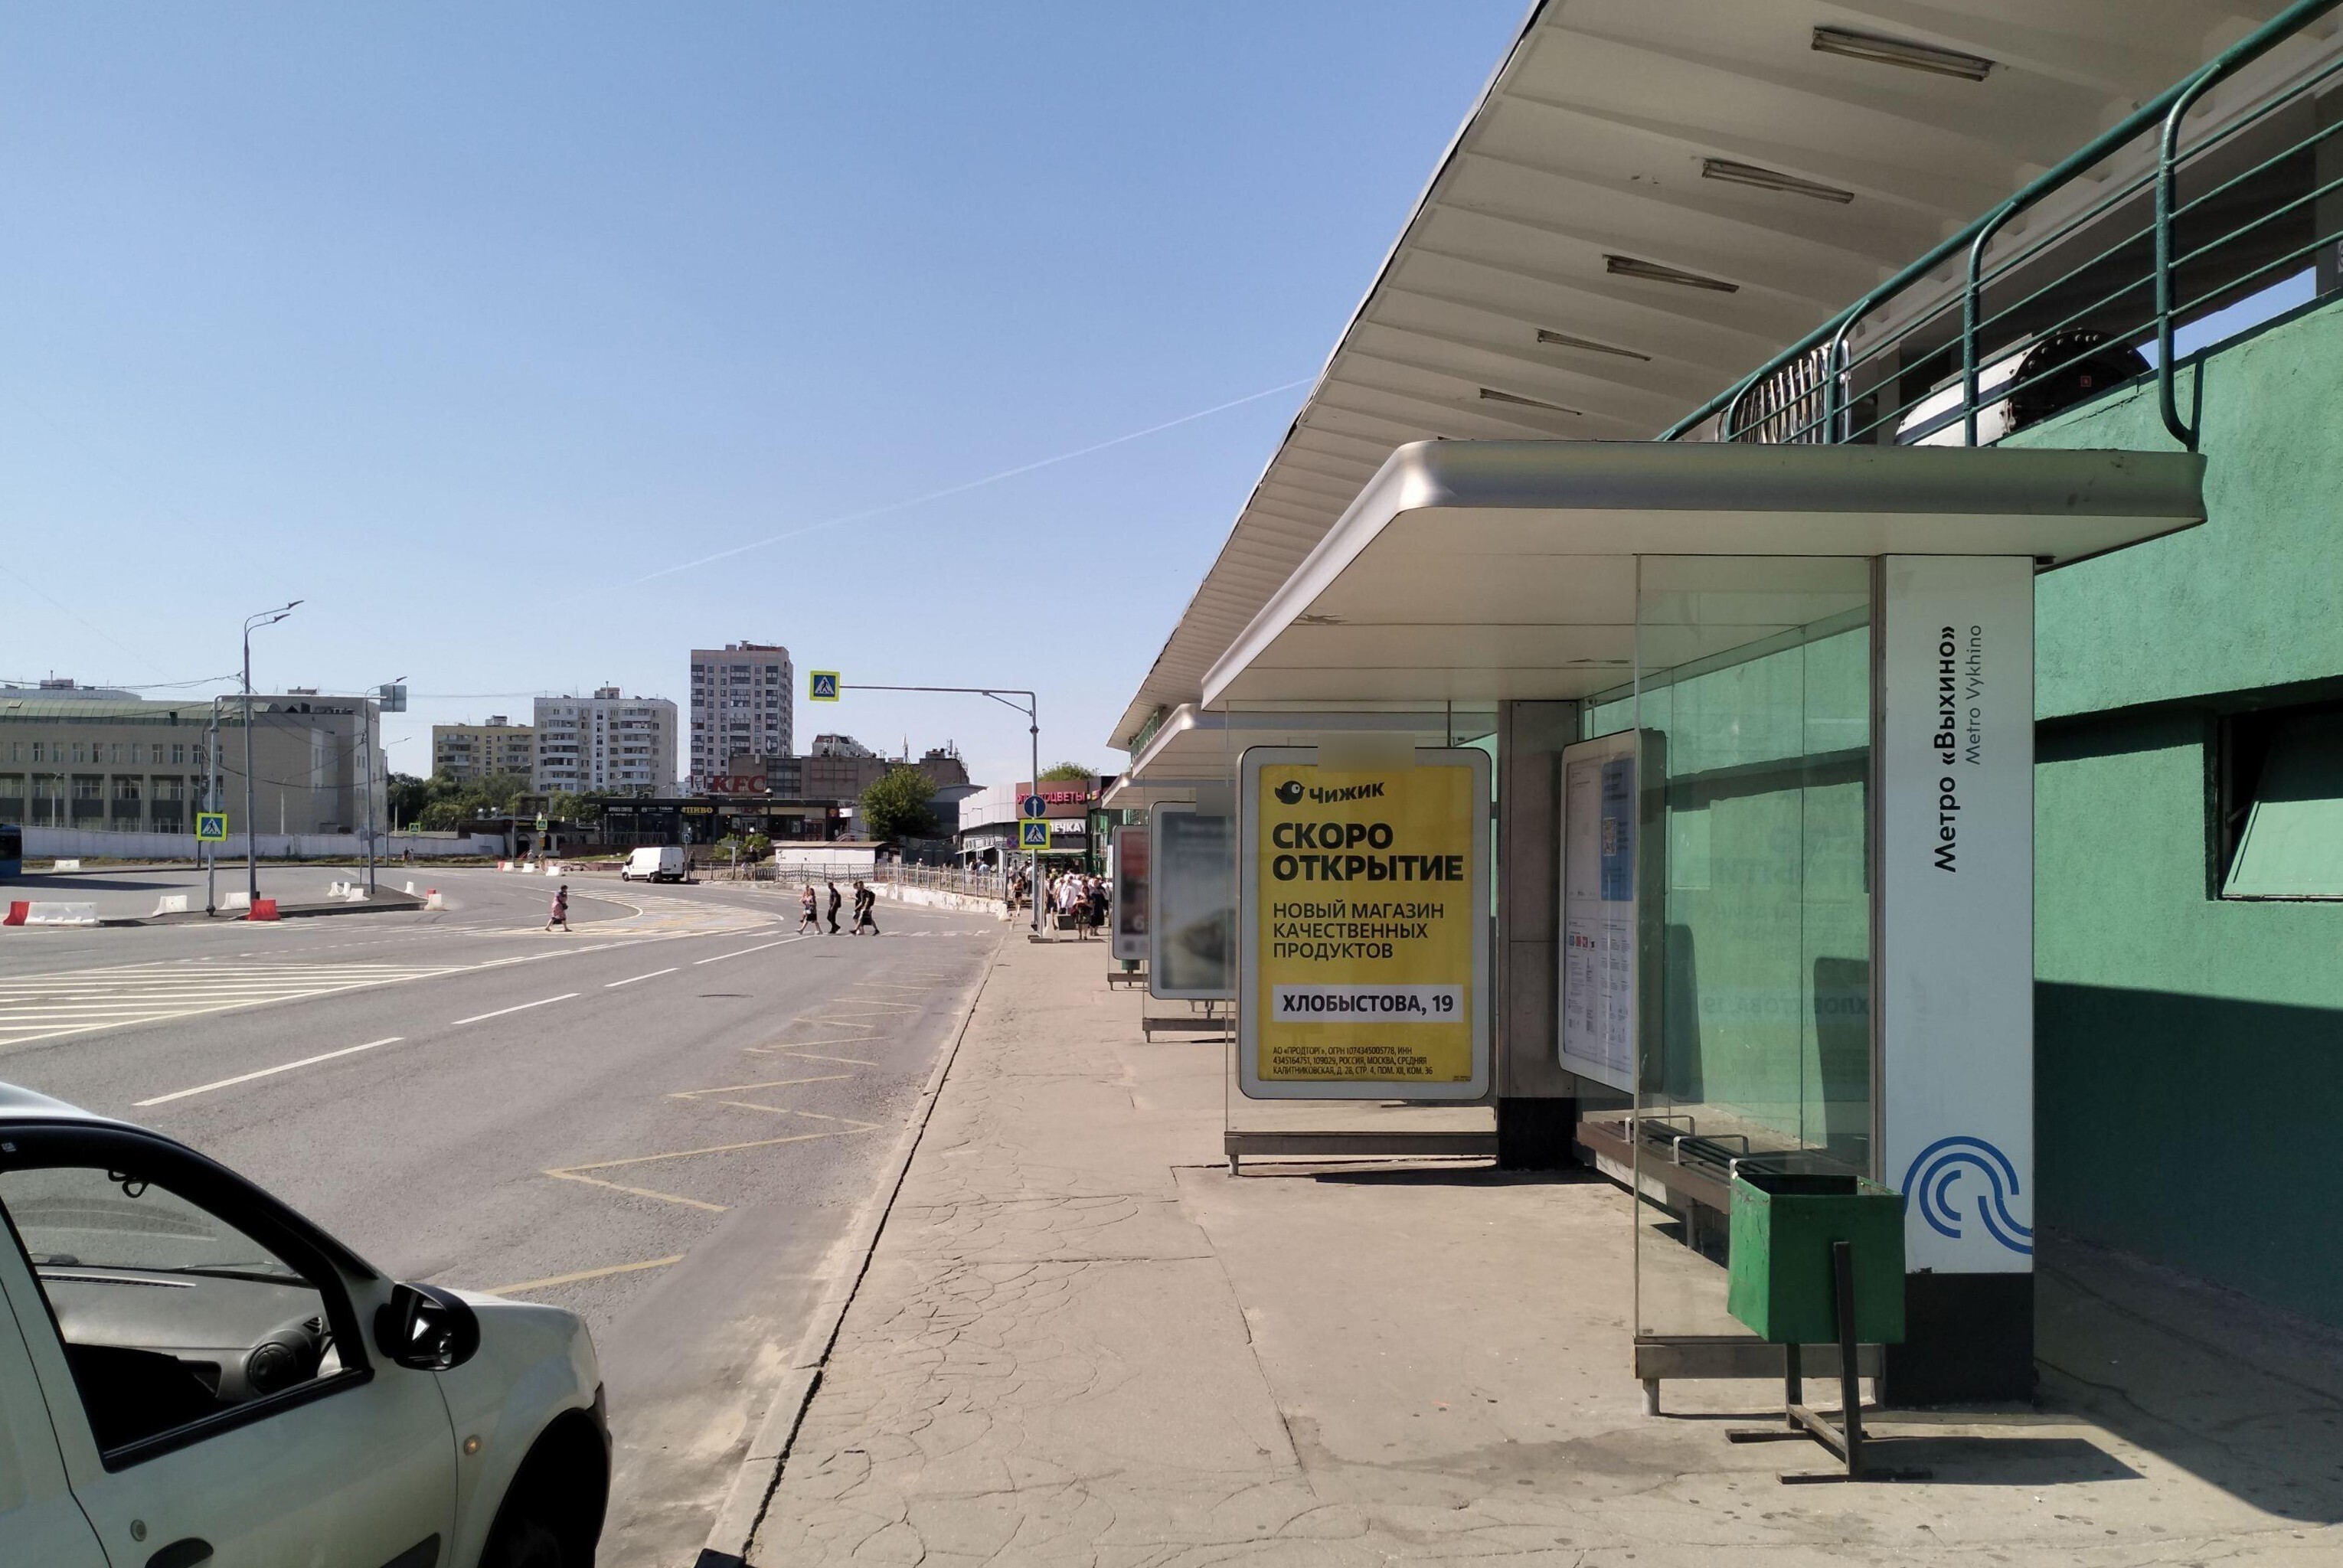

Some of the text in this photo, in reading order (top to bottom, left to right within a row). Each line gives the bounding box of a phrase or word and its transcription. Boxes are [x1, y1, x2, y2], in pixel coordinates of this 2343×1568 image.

[1965, 625, 1985, 766] Metro Vykhino
[1933, 626, 1961, 873] Метро «Выхино»
[711, 775, 766, 793] KFC
[1309, 781, 1385, 805] Чижик
[1273, 822, 1394, 849] СКОРО
[1273, 854, 1464, 881] ОТКРЫТИЕ
[1273, 900, 1444, 920] НОВЫЙ МАГАЗИН
[1273, 923, 1428, 939] КАЧЕСТВЕННЫХ
[1273, 942, 1394, 961] ПРОДУКТОВ
[1283, 994, 1454, 1016] ХЛОБЫСТОВА, 19
[1273, 1047, 1283, 1055] АО
[1328, 1047, 1345, 1055] ОГРН
[1397, 1047, 1413, 1055] ИНН
[1339, 1057, 1365, 1066] РОССИЯ,
[1367, 1057, 1396, 1066] МОСКВА,
[1397, 1057, 1427, 1065] СРЕДНЯЯ
